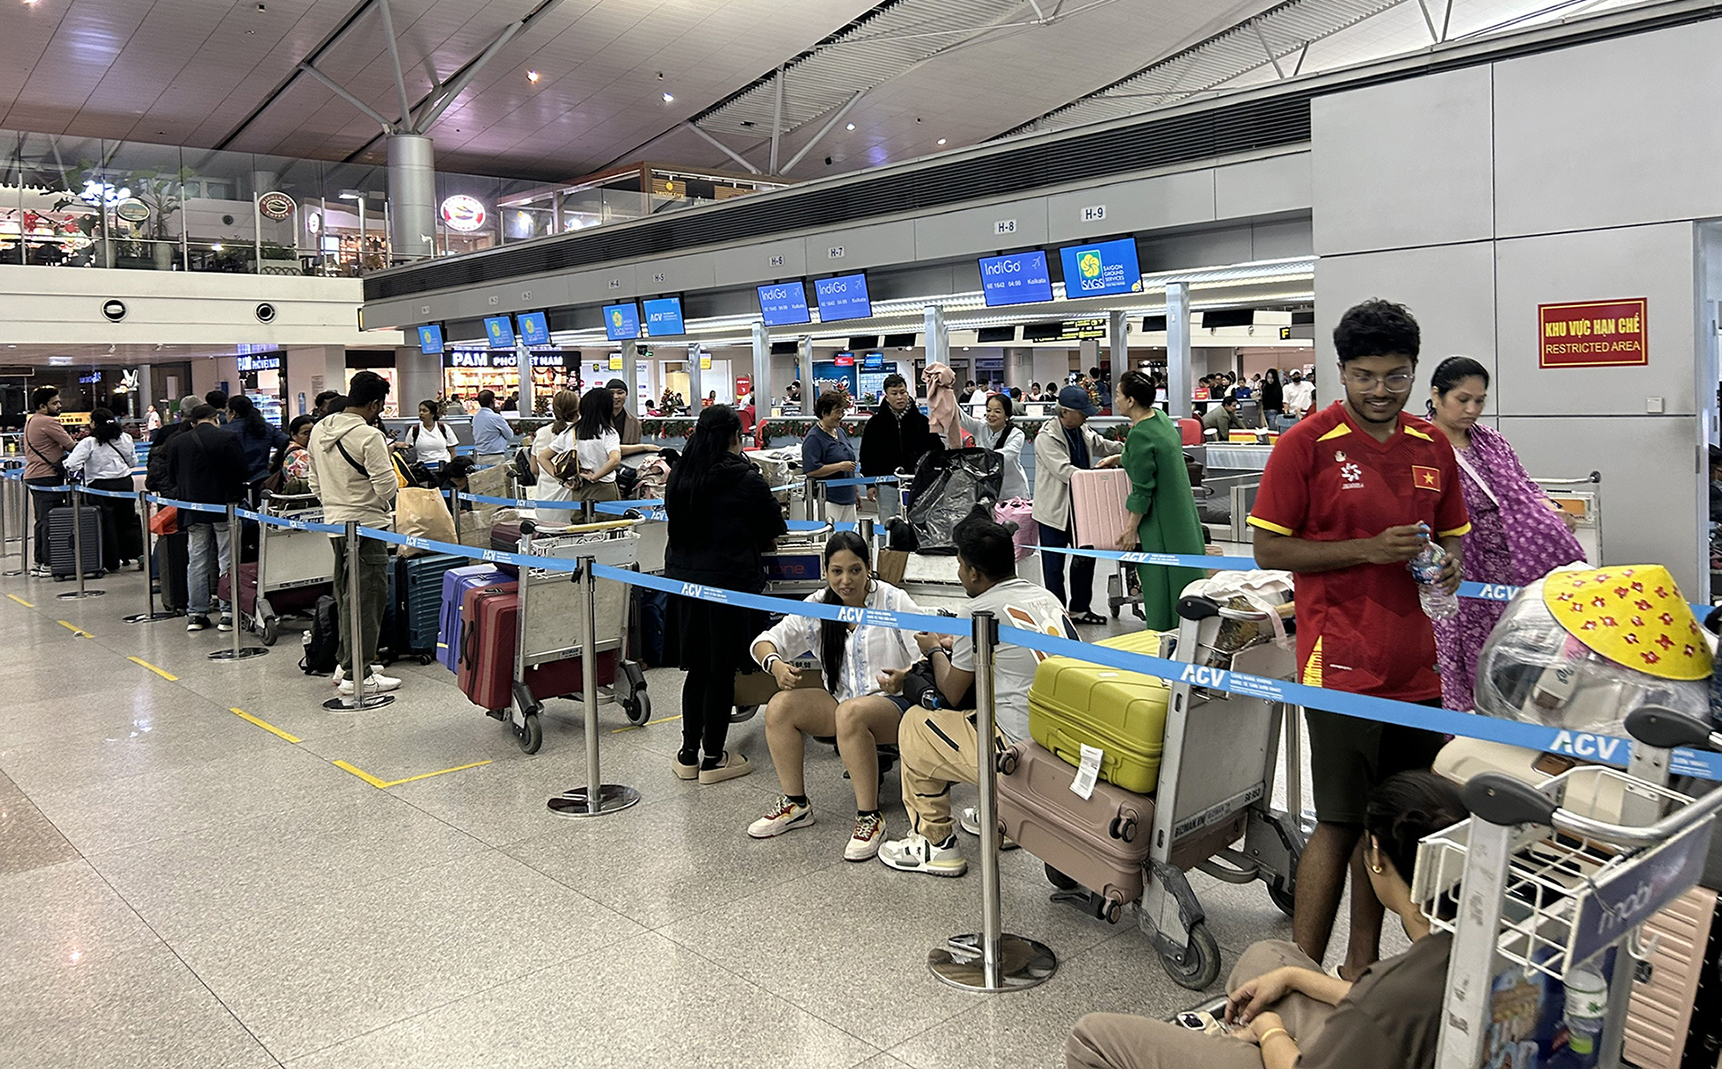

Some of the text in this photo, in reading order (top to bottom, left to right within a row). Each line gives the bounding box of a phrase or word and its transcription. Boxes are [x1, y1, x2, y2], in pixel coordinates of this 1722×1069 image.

[1085, 207, 1104, 220] H-9
[998, 221, 1015, 232] H-8
[830, 247, 843, 257] H-7
[771, 256, 783, 265] H-6
[984, 259, 1021, 276] IndiGo
[1027, 277, 1046, 285] Kolkata
[1082, 278, 1103, 289] SAGS
[761, 287, 787, 301] IndiGo
[819, 281, 847, 295] IndiGo
[650, 312, 662, 322] ACV
[1545, 312, 1640, 338] KHU VỰC HẠN CHẾ
[1281, 328, 1290, 339] F
[1546, 341, 1641, 354] RESTRICTED AREA
[452, 352, 488, 366] PAM
[540, 355, 563, 366] NAM
[1119, 551, 1149, 562] ACV
[681, 582, 702, 597] ACV
[1479, 584, 1520, 600] ACV
[838, 606, 863, 622] ACV
[1180, 664, 1226, 688] ACV
[1550, 730, 1619, 760] ACV
